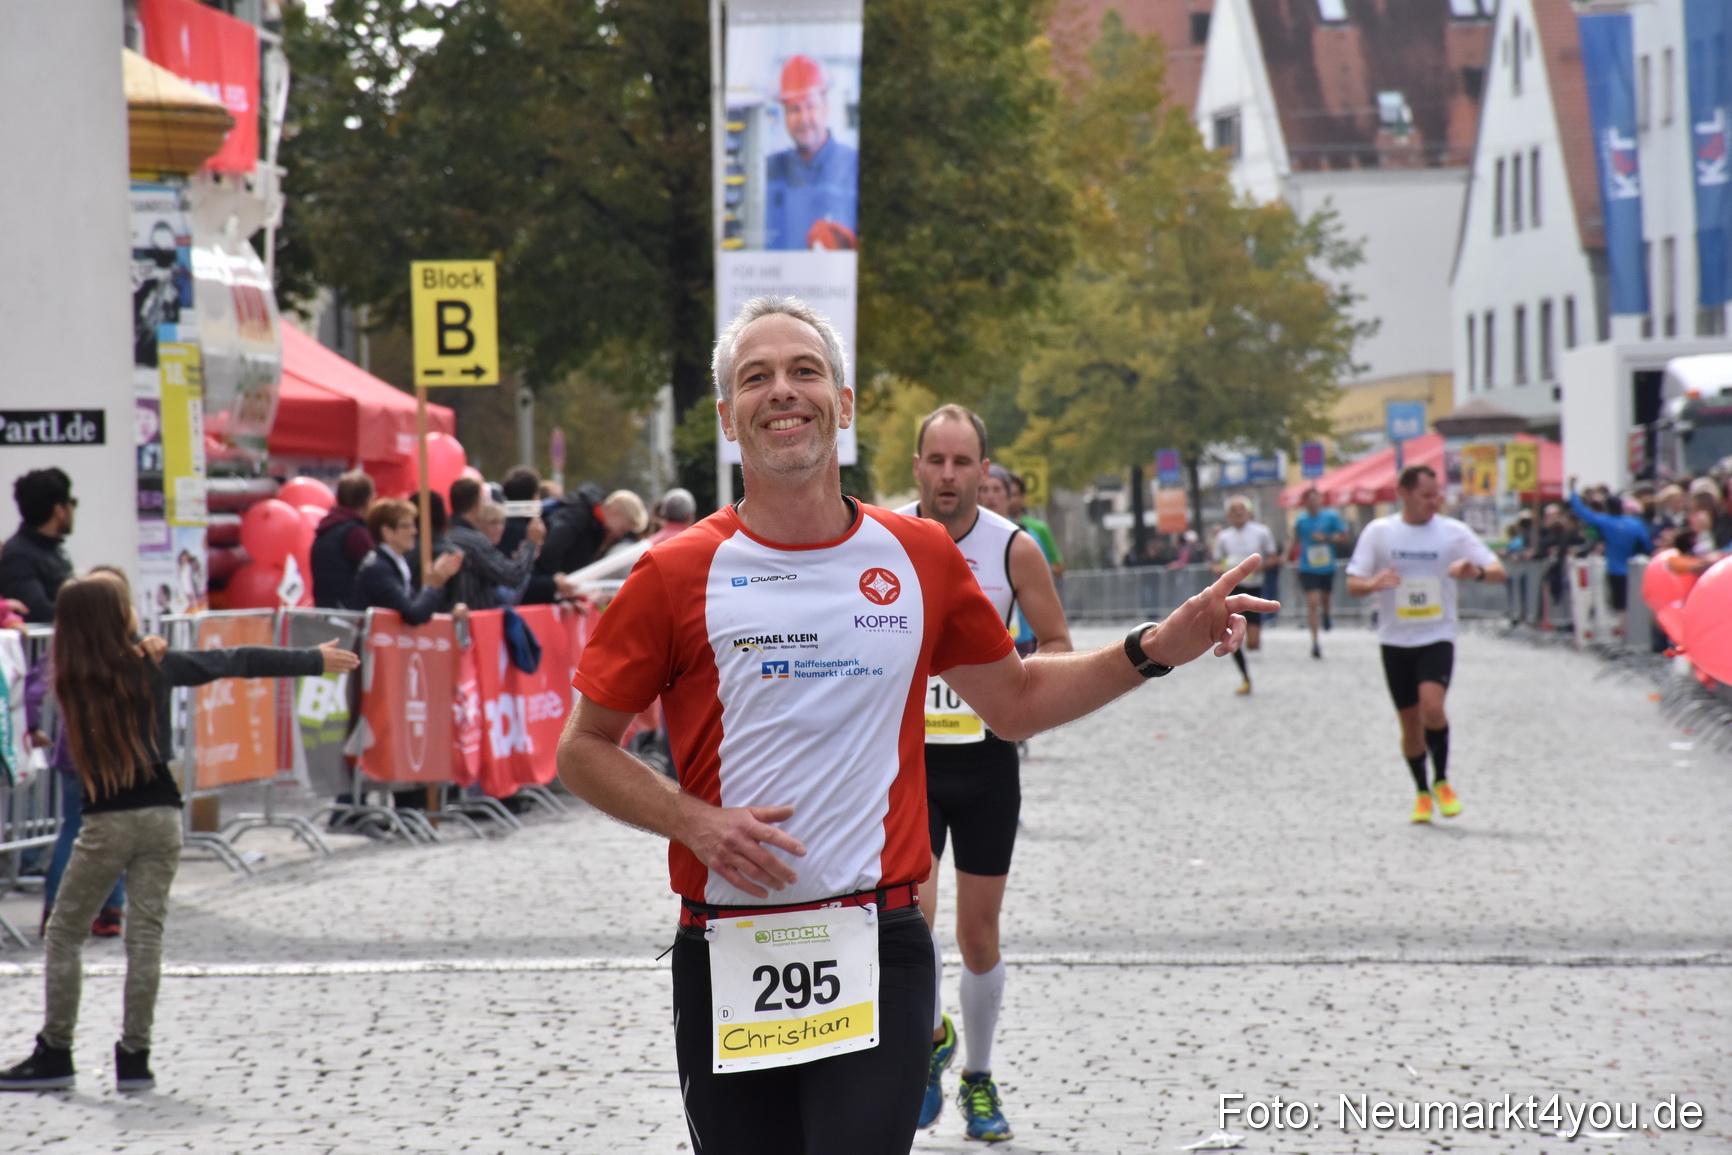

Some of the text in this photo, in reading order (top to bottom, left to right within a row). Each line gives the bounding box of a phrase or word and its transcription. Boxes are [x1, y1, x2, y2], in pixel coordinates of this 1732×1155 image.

[422, 267, 485, 290] Block
[436, 300, 476, 356] B
[854, 615, 908, 630] KOPPE
[733, 633, 818, 647] MICHAEL KLEIN
[794, 658, 860, 668] Raiffeisenbank
[794, 669, 838, 678] Neumarkt
[872, 668, 883, 676] eG
[771, 925, 830, 942] BOCK
[753, 960, 841, 1012] 295
[723, 1009, 729, 1018] D
[723, 1016, 850, 1051] Christian
